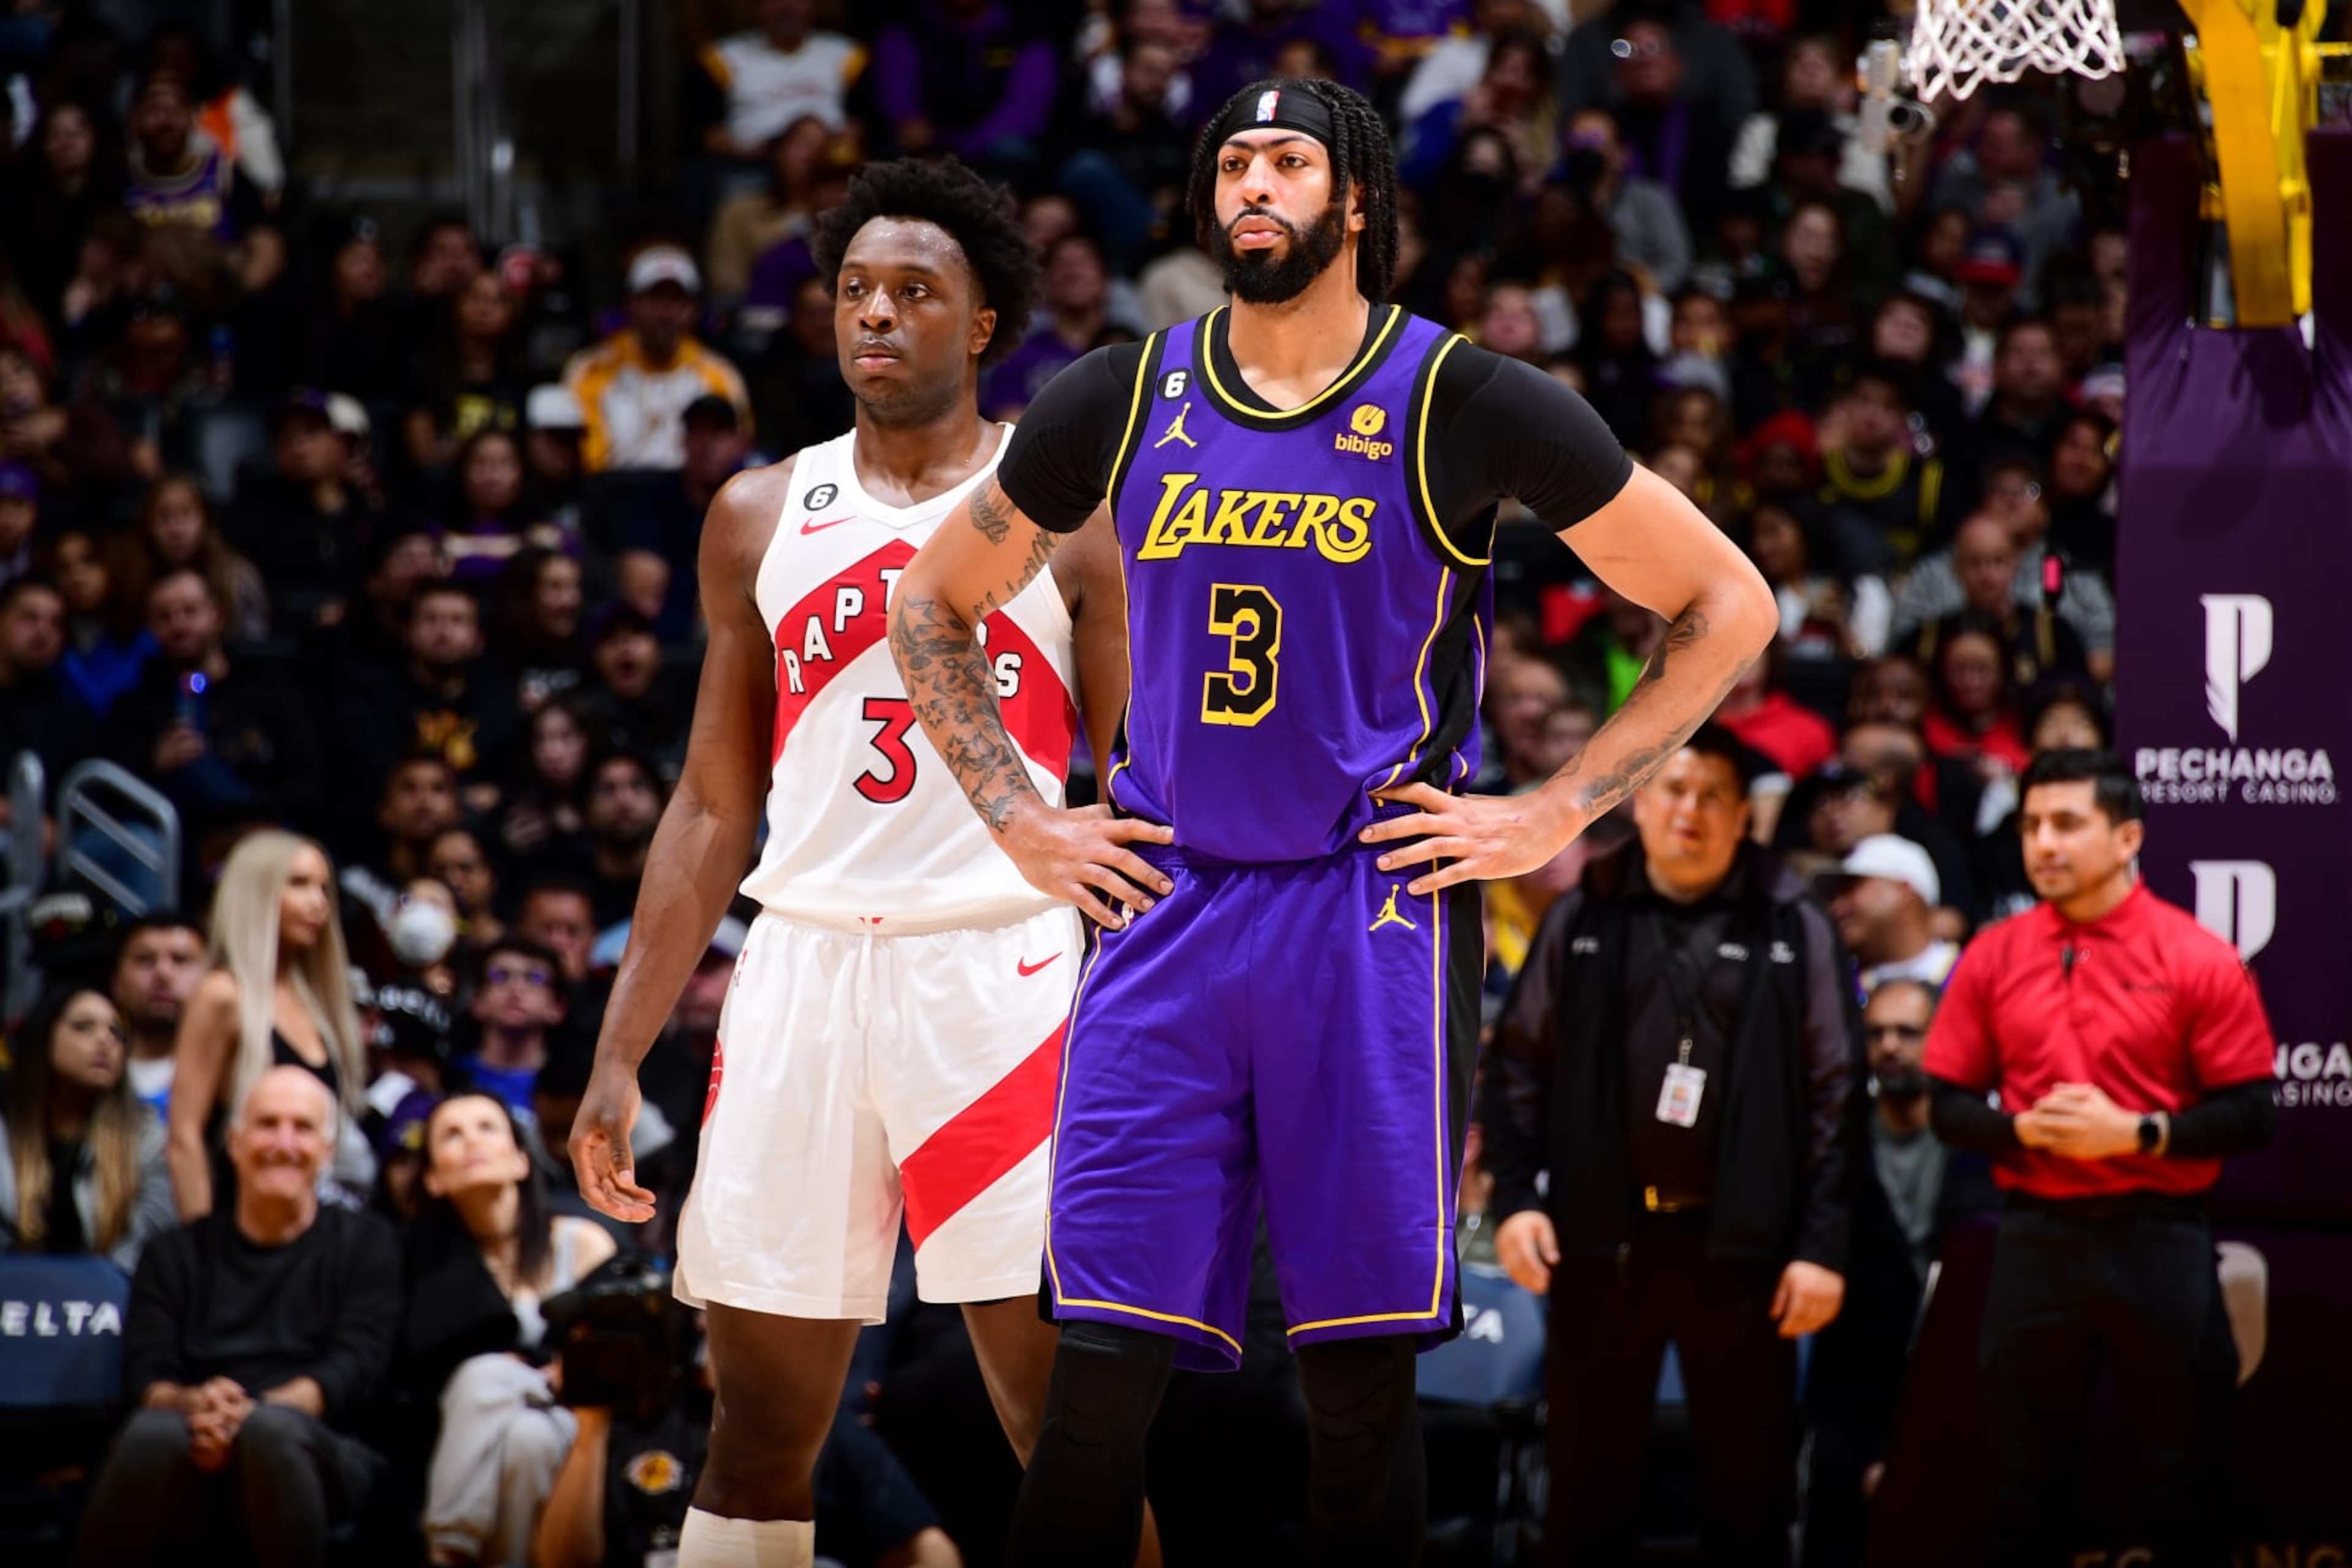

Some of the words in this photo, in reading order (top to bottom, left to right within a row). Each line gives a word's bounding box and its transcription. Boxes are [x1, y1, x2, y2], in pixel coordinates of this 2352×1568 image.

[1164, 371, 1187, 399] 6
[1335, 432, 1393, 461] bibigo
[809, 485, 834, 510] 6
[1136, 472, 1378, 564] LAKERS
[782, 568, 1023, 699] RAPTS
[1200, 582, 1283, 728] 3
[853, 697, 918, 804] 3
[2134, 747, 2335, 782] PECHANGA
[2138, 779, 2232, 804] RESORT
[2271, 1079, 2352, 1108] SINO
[0, 1299, 123, 1338] ELTA
